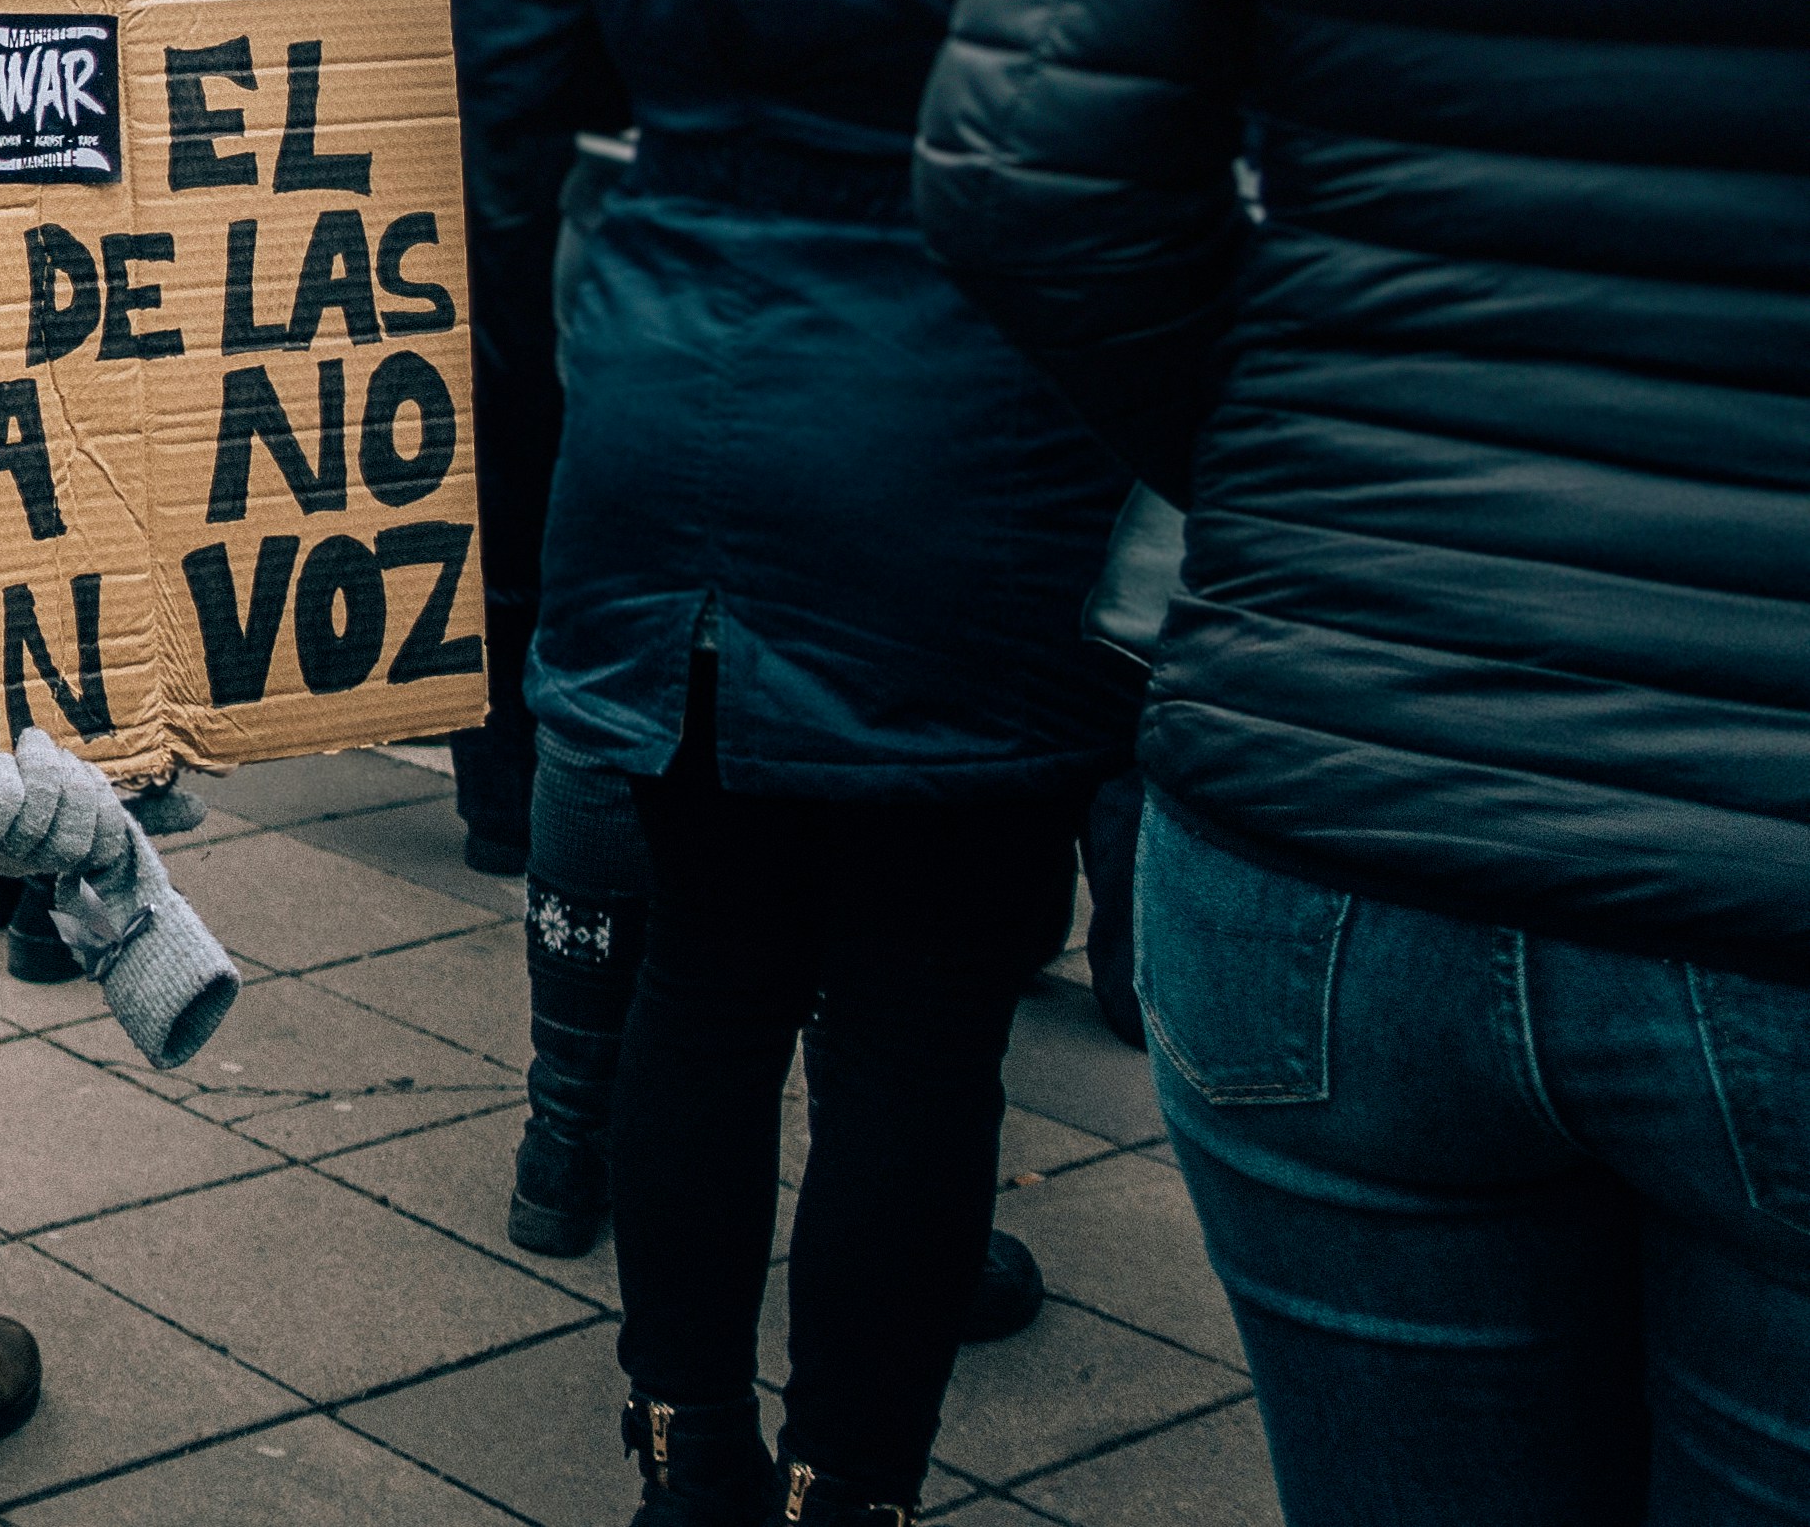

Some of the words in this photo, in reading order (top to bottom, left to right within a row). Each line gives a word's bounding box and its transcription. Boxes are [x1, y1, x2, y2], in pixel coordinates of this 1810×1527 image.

[164, 35, 372, 196] EL
[24, 223, 184, 367] DE
[221, 208, 457, 356] LAS
[205, 350, 457, 523] NO
[181, 520, 484, 708] VOZ
